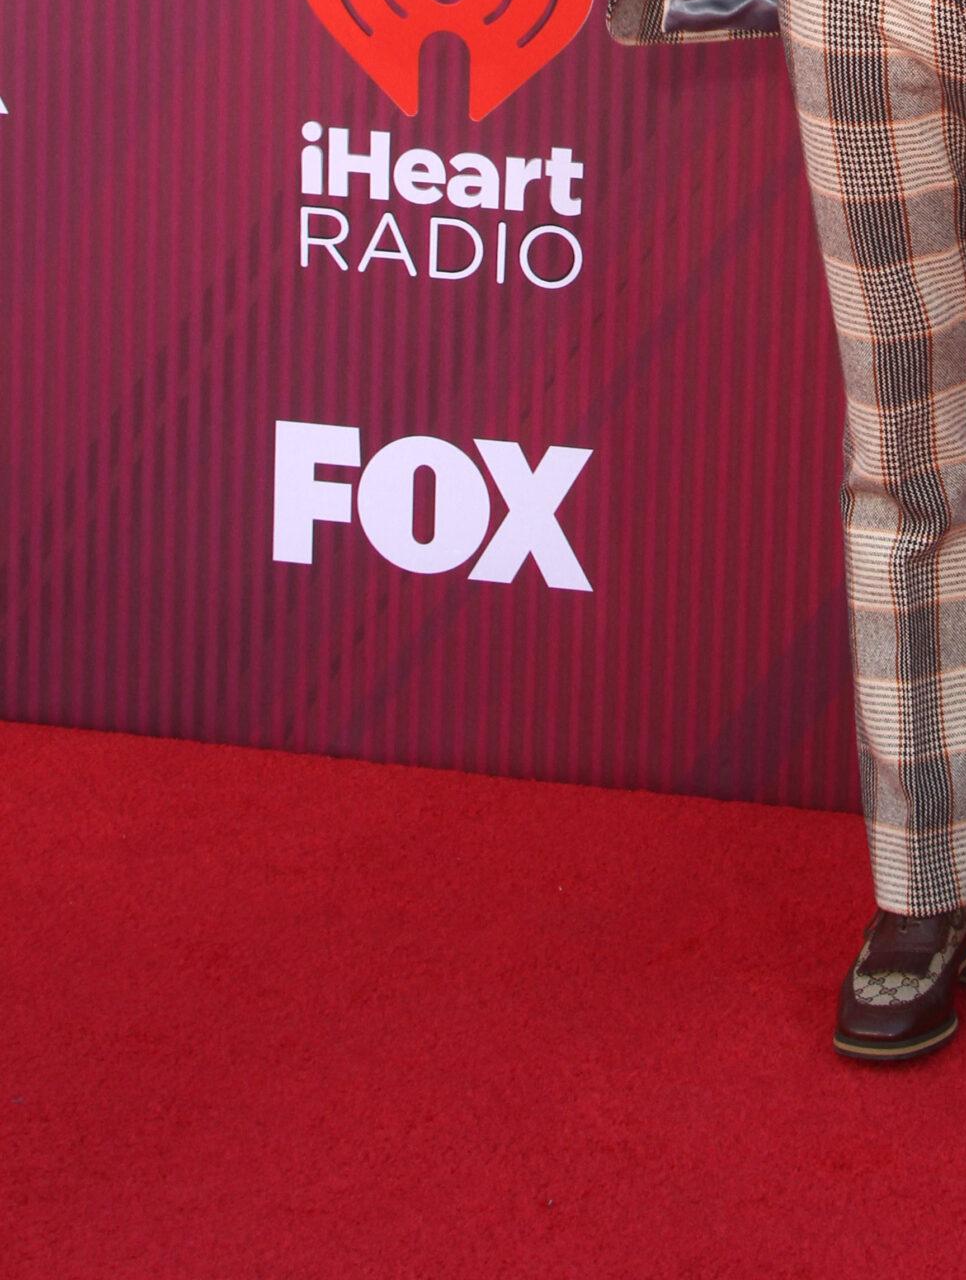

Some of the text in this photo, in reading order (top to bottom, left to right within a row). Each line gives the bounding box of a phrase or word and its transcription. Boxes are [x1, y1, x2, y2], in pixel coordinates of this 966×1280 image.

[301, 120, 584, 217] iHeart
[300, 206, 583, 289] RADIO
[272, 419, 594, 592] FOX
